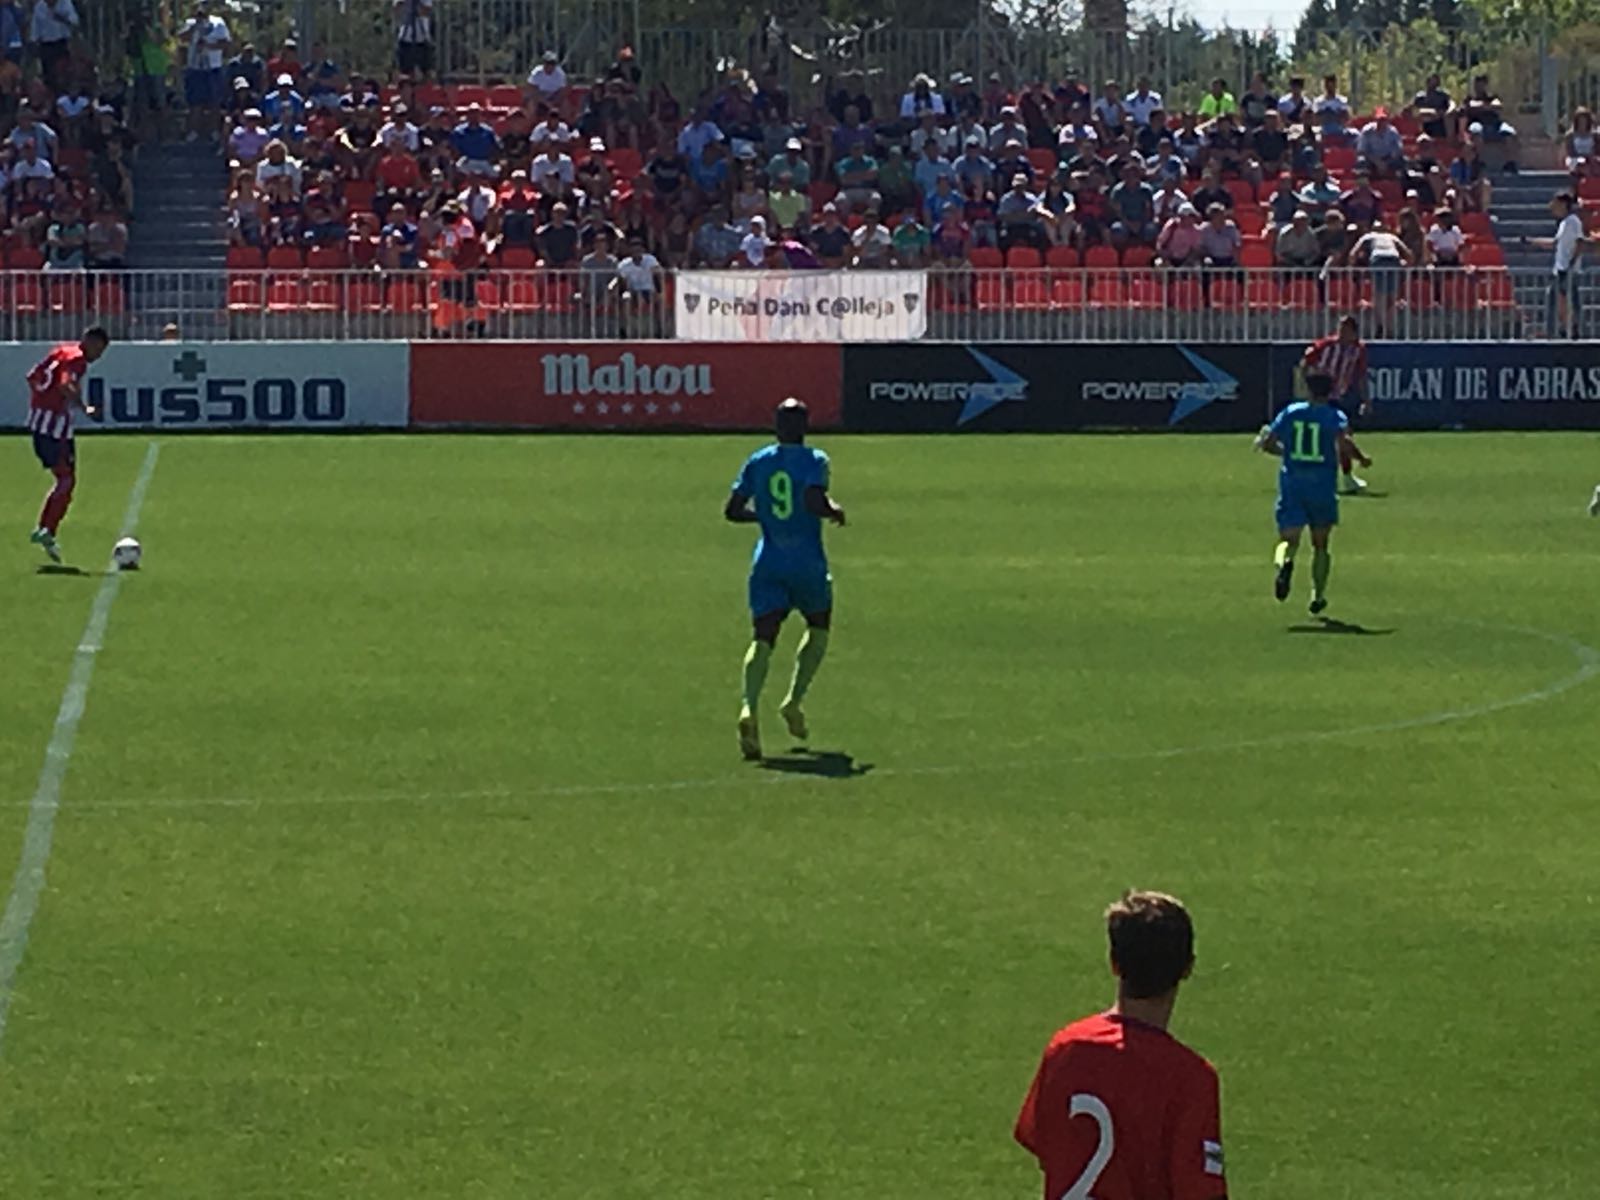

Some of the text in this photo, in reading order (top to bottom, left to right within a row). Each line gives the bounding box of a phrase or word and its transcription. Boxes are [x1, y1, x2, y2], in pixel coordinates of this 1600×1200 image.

[707, 297, 895, 320] Peña Dani C@lleja
[540, 352, 715, 396] Mahou
[1082, 382, 1240, 401] POWERADE
[1455, 367, 1488, 400] DE
[1499, 367, 1600, 400] CABRAS
[86, 377, 346, 424] lus500
[1291, 420, 1325, 463] 11
[769, 470, 793, 521] 9
[1061, 1093, 1115, 1200] 2
